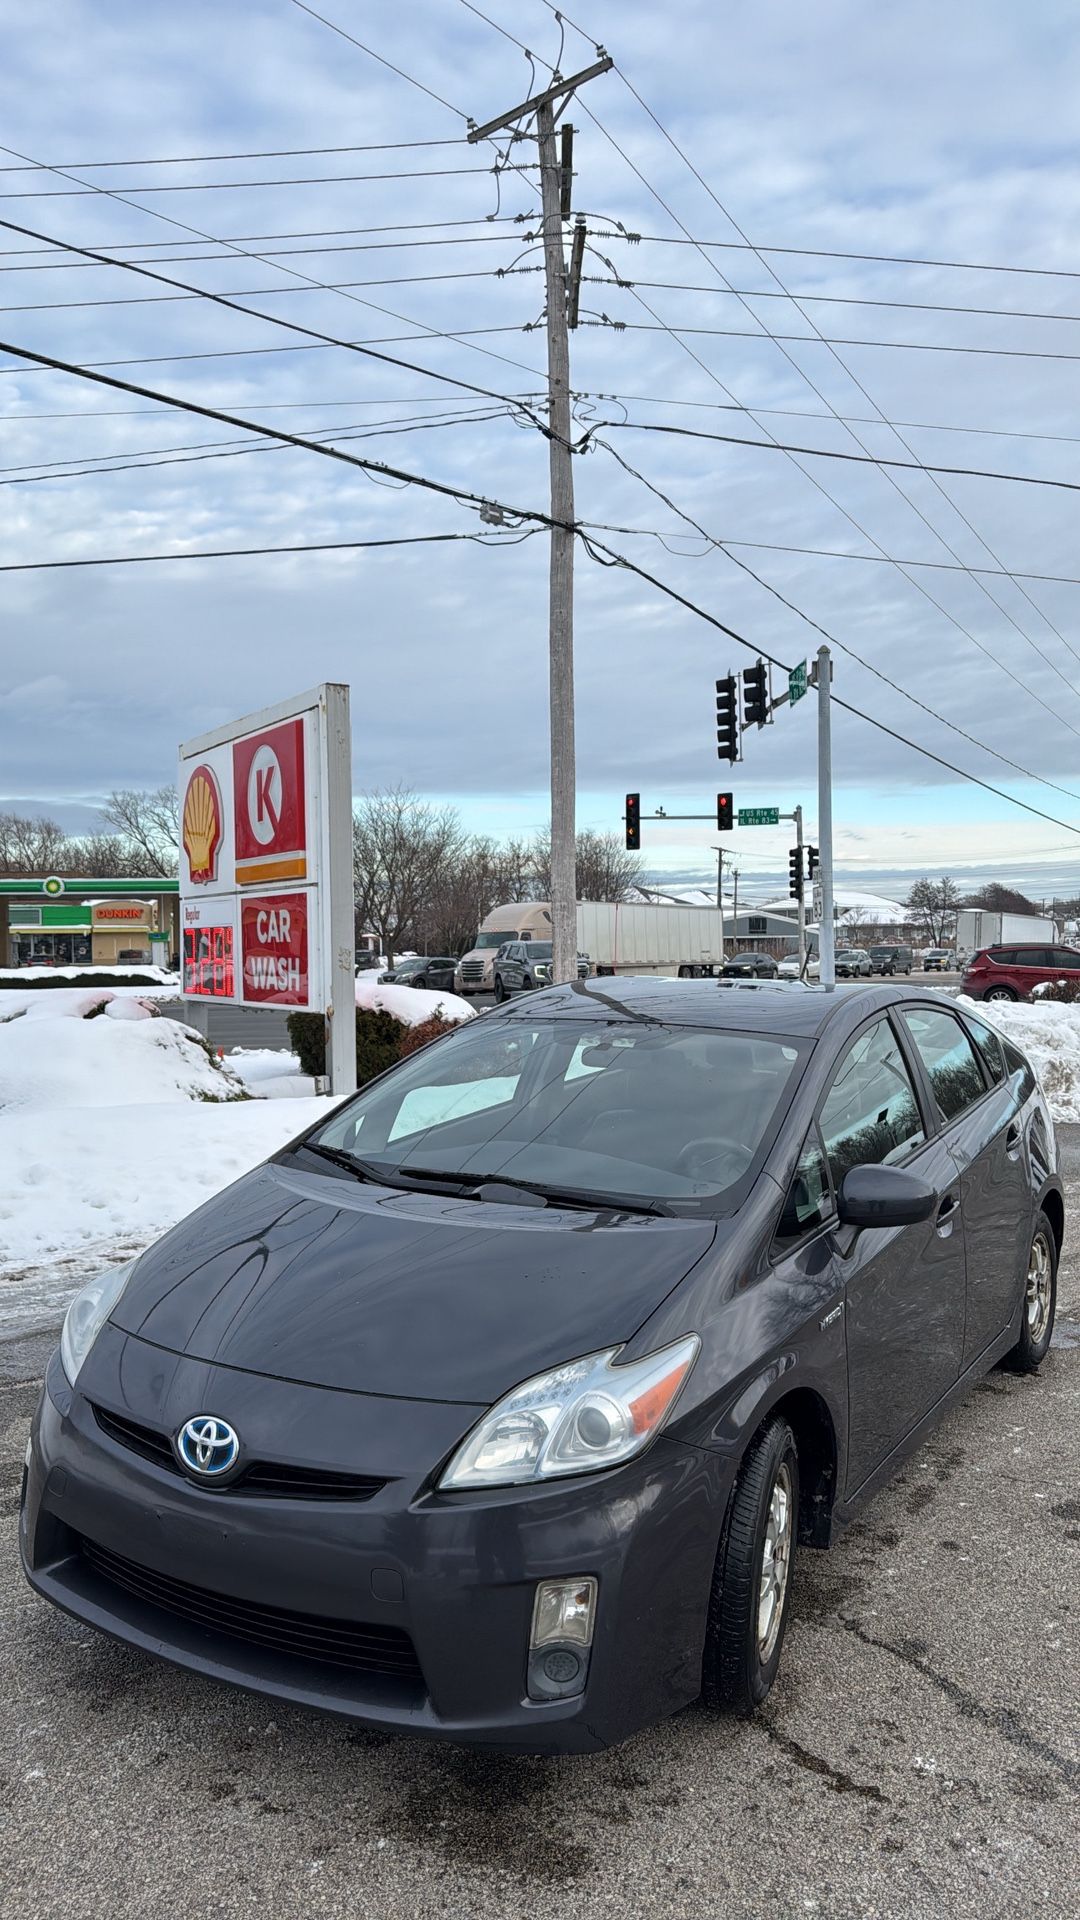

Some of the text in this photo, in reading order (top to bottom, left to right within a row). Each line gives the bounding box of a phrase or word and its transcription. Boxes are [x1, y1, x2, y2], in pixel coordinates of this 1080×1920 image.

[256, 765, 278, 834] K
[185, 905, 200, 924] Regular
[256, 909, 291, 944] CAR
[250, 956, 300, 992] WASH
